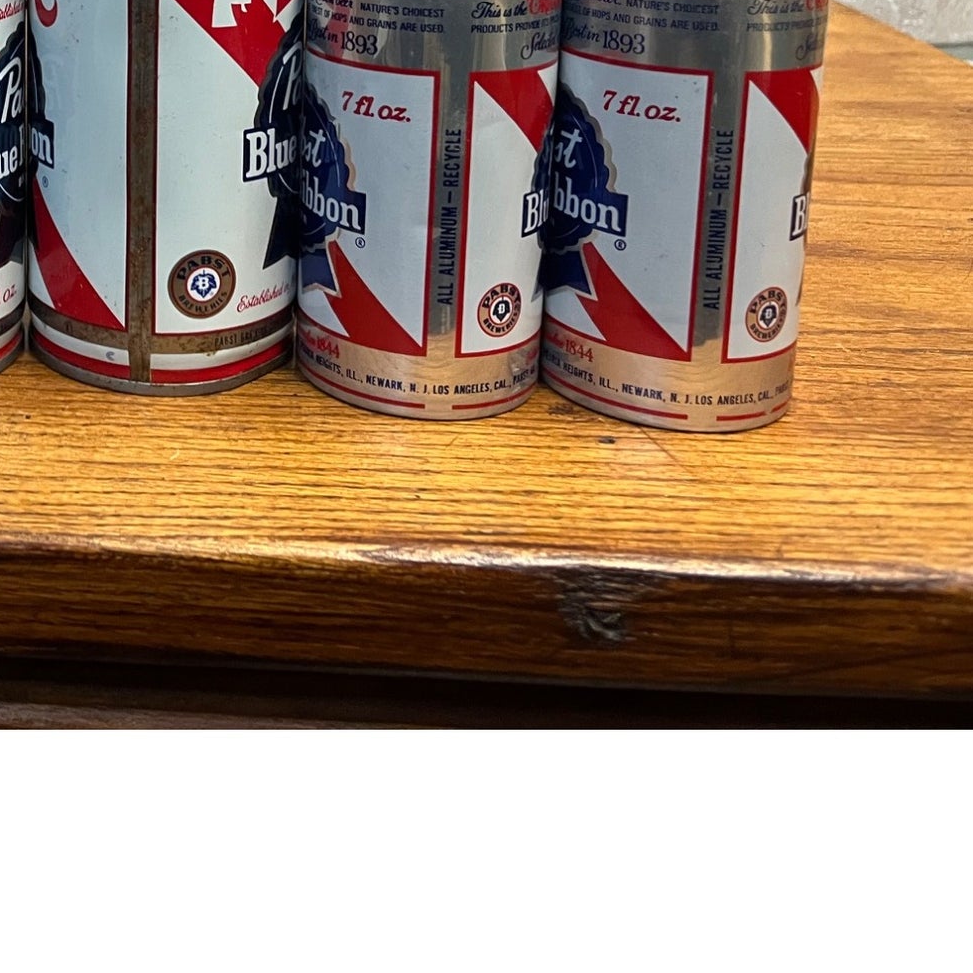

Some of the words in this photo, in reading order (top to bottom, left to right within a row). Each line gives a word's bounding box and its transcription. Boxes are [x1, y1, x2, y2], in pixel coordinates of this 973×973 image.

[360, 2, 399, 16] NATURE'S
[402, 7, 445, 18] CHOICEST
[471, 1, 501, 19] This
[503, 6, 513, 17] is
[513, 0, 528, 16] the
[673, 2, 720, 15] CHOICEST
[779, 1, 788, 14] is
[349, 15, 365, 26] AND
[367, 18, 398, 30] GRAINS
[400, 22, 418, 33] ARE
[470, 23, 514, 34] PRODUCTS
[591, 9, 611, 21] HOPS
[613, 13, 631, 25] AND
[633, 15, 668, 29] GRAINS
[670, 19, 690, 31] ARE
[692, 21, 720, 32] USED.
[328, 29, 339, 43] in
[341, 30, 378, 56] 1893
[586, 24, 600, 42] in
[602, 29, 646, 55] 1893
[341, 91, 355, 112] 7
[377, 104, 411, 123] oz.
[603, 90, 617, 112] 7
[644, 103, 681, 123] oz.
[245, 127, 298, 179] Blue
[443, 128, 462, 188] RECYCLE
[712, 130, 734, 190] RECYCLE
[437, 206, 459, 277] ALUMINUM
[703, 209, 727, 281] ALUMINUM
[177, 255, 231, 280] PABST
[178, 291, 227, 314] BREWERIES
[436, 282, 455, 306] ALL
[482, 284, 521, 309] PABST
[702, 286, 720, 310] ALL
[565, 338, 594, 363] 1844
[365, 374, 406, 393] NEWARK,
[409, 383, 420, 394] N.
[423, 384, 431, 395] J.
[432, 385, 449, 395] LOS
[453, 383, 493, 394] ANGELES,
[562, 361, 596, 386] HEIGHTS,
[621, 383, 667, 403] NEWARK,
[670, 392, 680, 403] N.
[685, 394, 693, 405] J.
[695, 395, 712, 405] LOS
[716, 393, 757, 405] ANGELES,
